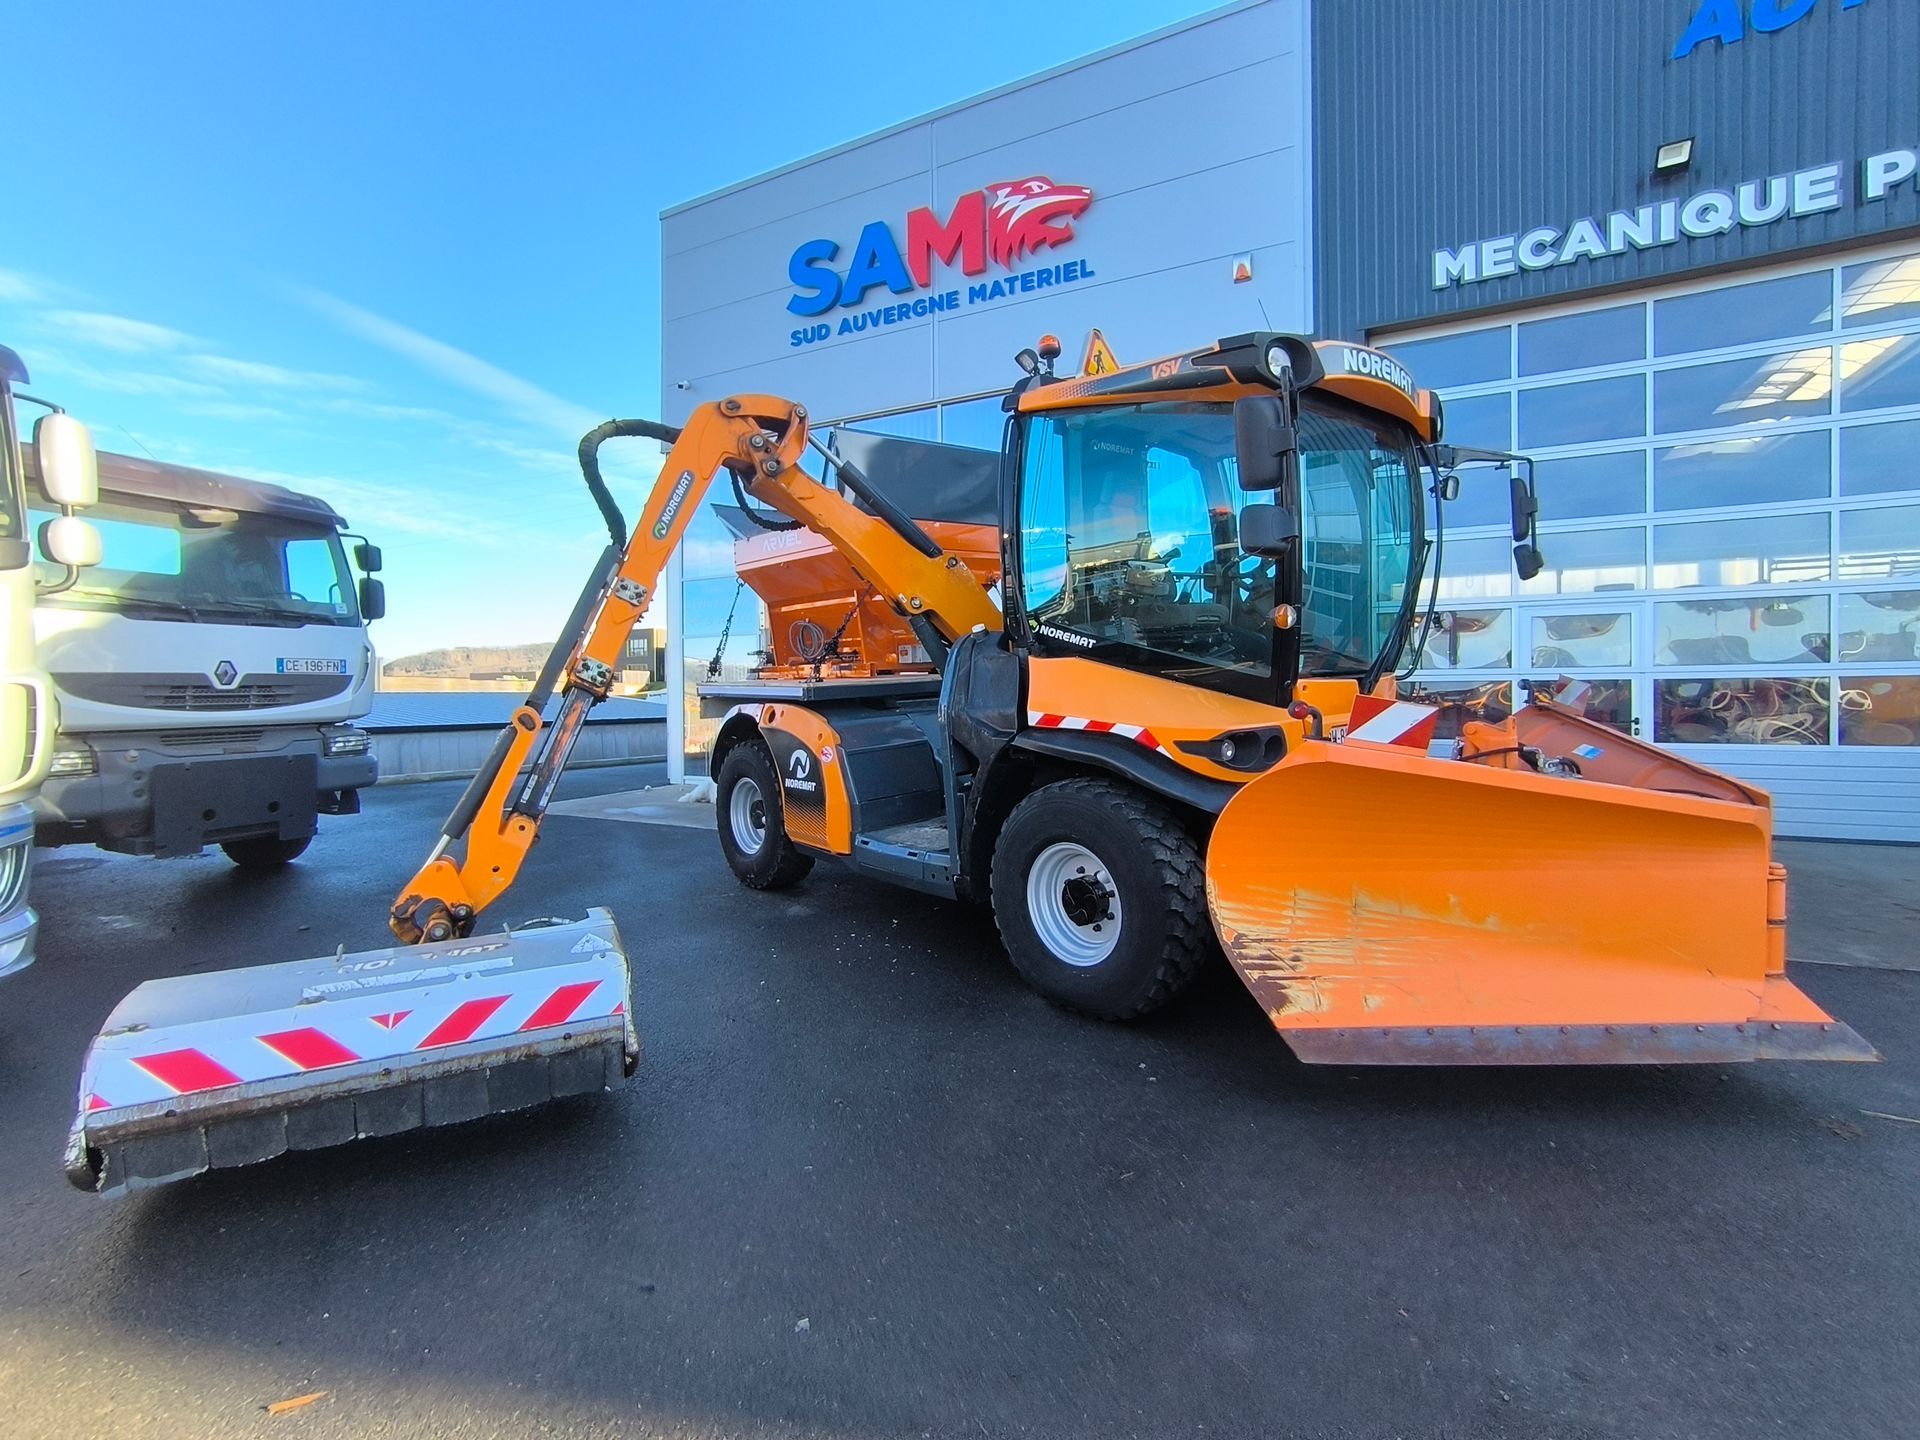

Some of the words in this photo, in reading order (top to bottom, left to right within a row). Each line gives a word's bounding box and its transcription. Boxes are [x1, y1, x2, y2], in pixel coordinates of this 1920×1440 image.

[1433, 163, 1841, 289] MECANIQUE
[1865, 149, 1919, 199] P
[786, 190, 987, 318] SAM
[790, 323, 831, 347] SUD
[837, 290, 960, 336] AUVERGNE
[968, 258, 1095, 305] MATERIEL
[1151, 357, 1183, 381] VSV
[1343, 348, 1413, 396] NOREMAT
[660, 471, 692, 524] NOREMAT
[1040, 624, 1097, 649] NOREMAT
[285, 660, 340, 672] CE-196-FN
[785, 778, 816, 792] NOREMAT
